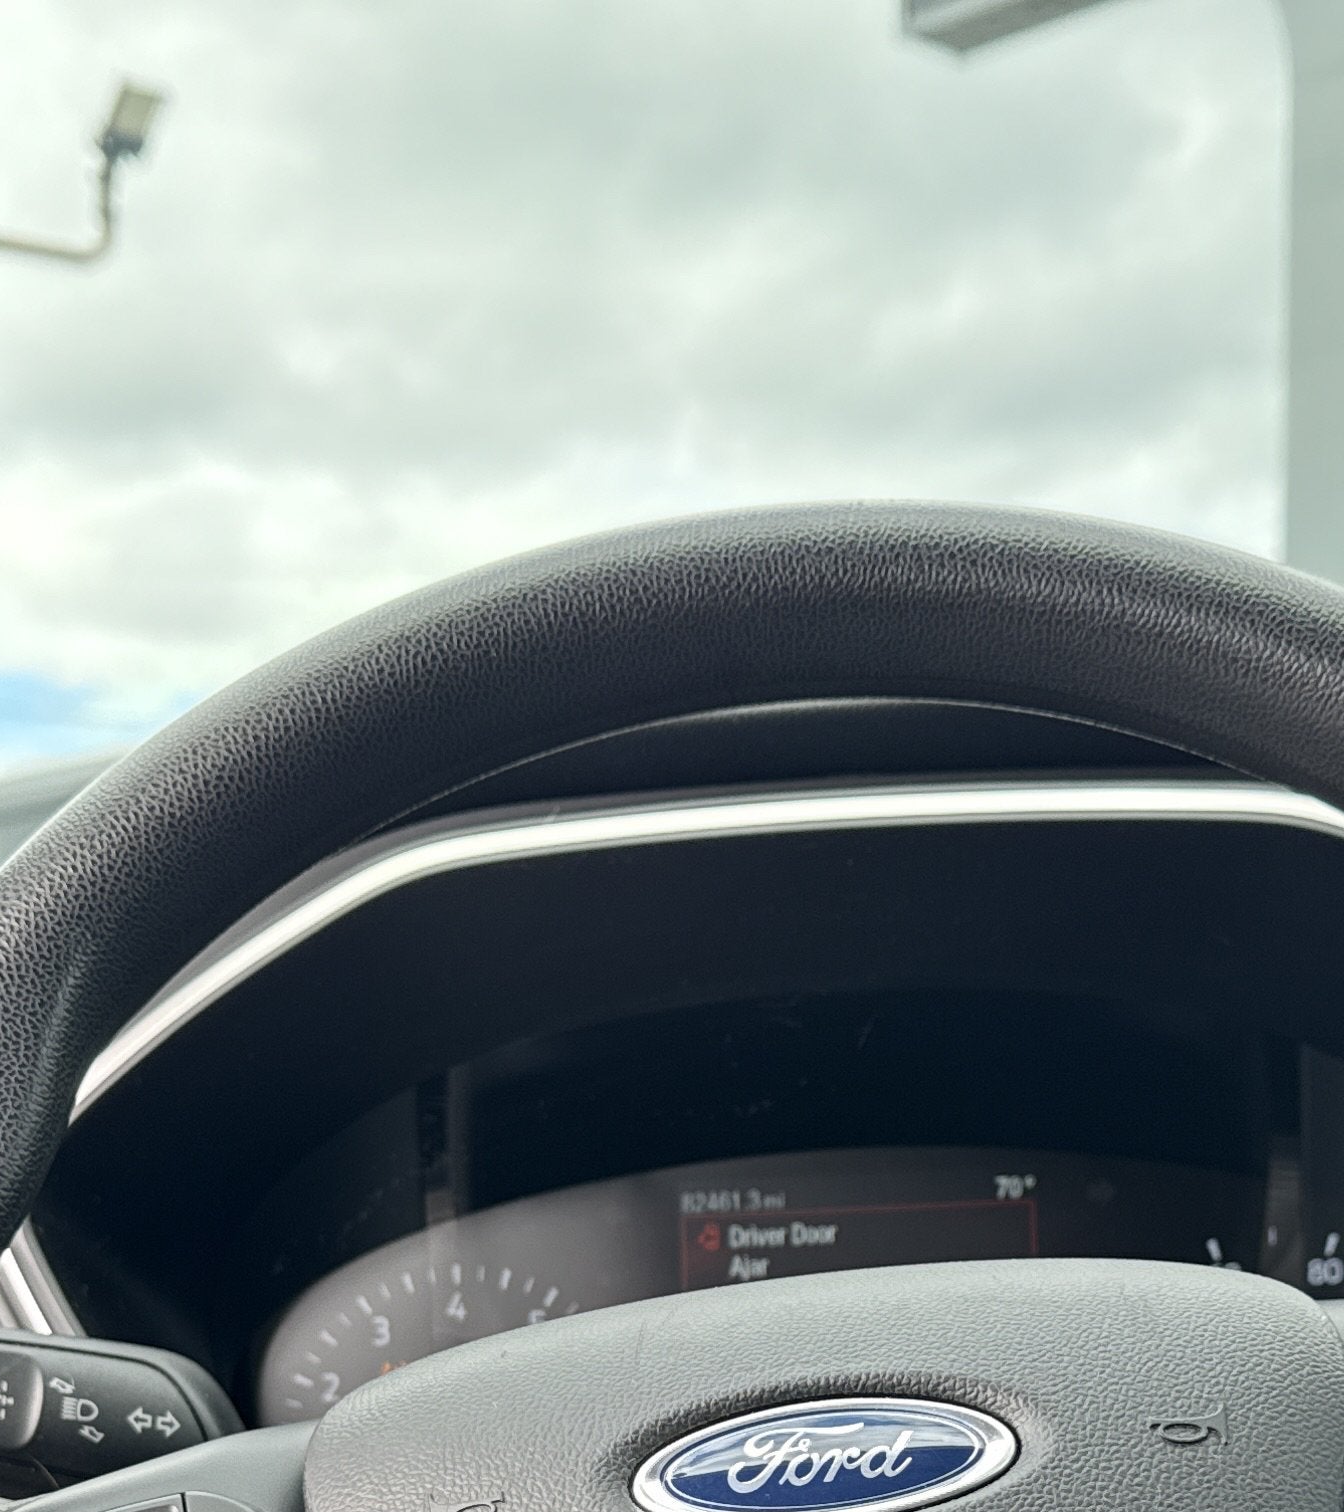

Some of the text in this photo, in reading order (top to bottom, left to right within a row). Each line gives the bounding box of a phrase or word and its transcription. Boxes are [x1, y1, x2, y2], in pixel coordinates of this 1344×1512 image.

[727, 1220, 838, 1249] Driver Door
[727, 1252, 770, 1281] Ajar
[320, 1371, 341, 1401] 2
[371, 1315, 391, 1347] 3
[446, 1291, 468, 1323] 4
[727, 1421, 915, 1495] Ford
